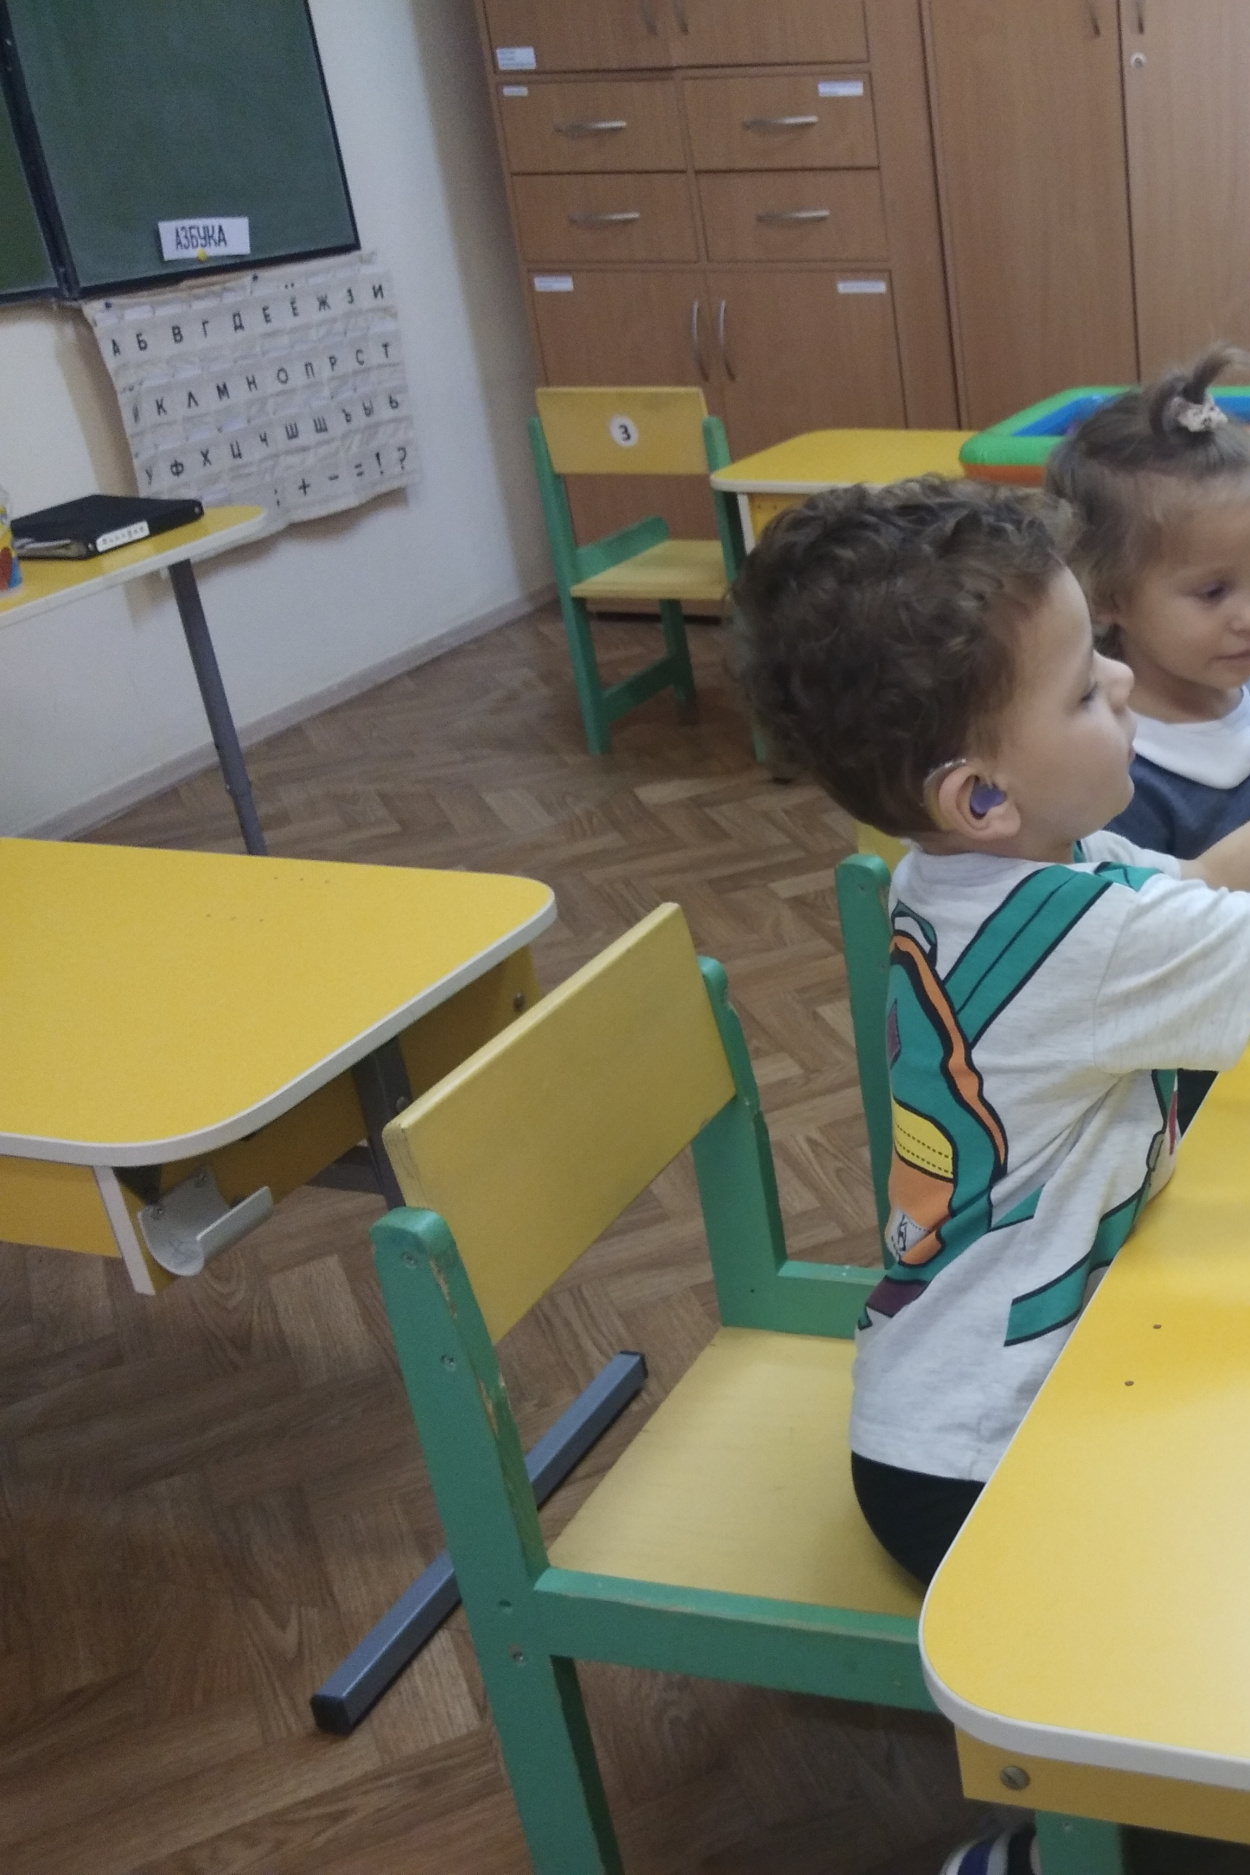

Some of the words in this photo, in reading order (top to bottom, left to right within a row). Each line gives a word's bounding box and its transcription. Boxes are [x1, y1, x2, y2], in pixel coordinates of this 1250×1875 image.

[175, 224, 227, 250] АЗБУКА
[111, 338, 121, 357] А
[136, 332, 148, 351] Б
[171, 325, 184, 344] В
[201, 319, 209, 338] Г
[232, 311, 245, 333] Д
[262, 305, 272, 324] Е
[316, 293, 331, 312] Ж
[346, 287, 355, 304] З
[372, 284, 385, 300] И
[155, 396, 167, 416] К
[187, 391, 199, 409] Л
[216, 381, 230, 401] М
[246, 374, 258, 392] Н
[276, 367, 289, 385] О
[304, 361, 315, 379] П
[329, 355, 337, 372] Р
[355, 349, 365, 366] С
[381, 342, 390, 359] Т
[170, 458, 184, 477] Ф
[200, 448, 212, 467] Х
[230, 440, 242, 459] Ц
[259, 430, 269, 447] Ч
[285, 422, 299, 440] Ш
[362, 400, 374, 418] Ы
[389, 394, 399, 410] Ь
[618, 424, 631, 441] 3
[375, 451, 384, 475] !
[397, 446, 407, 470] ?
